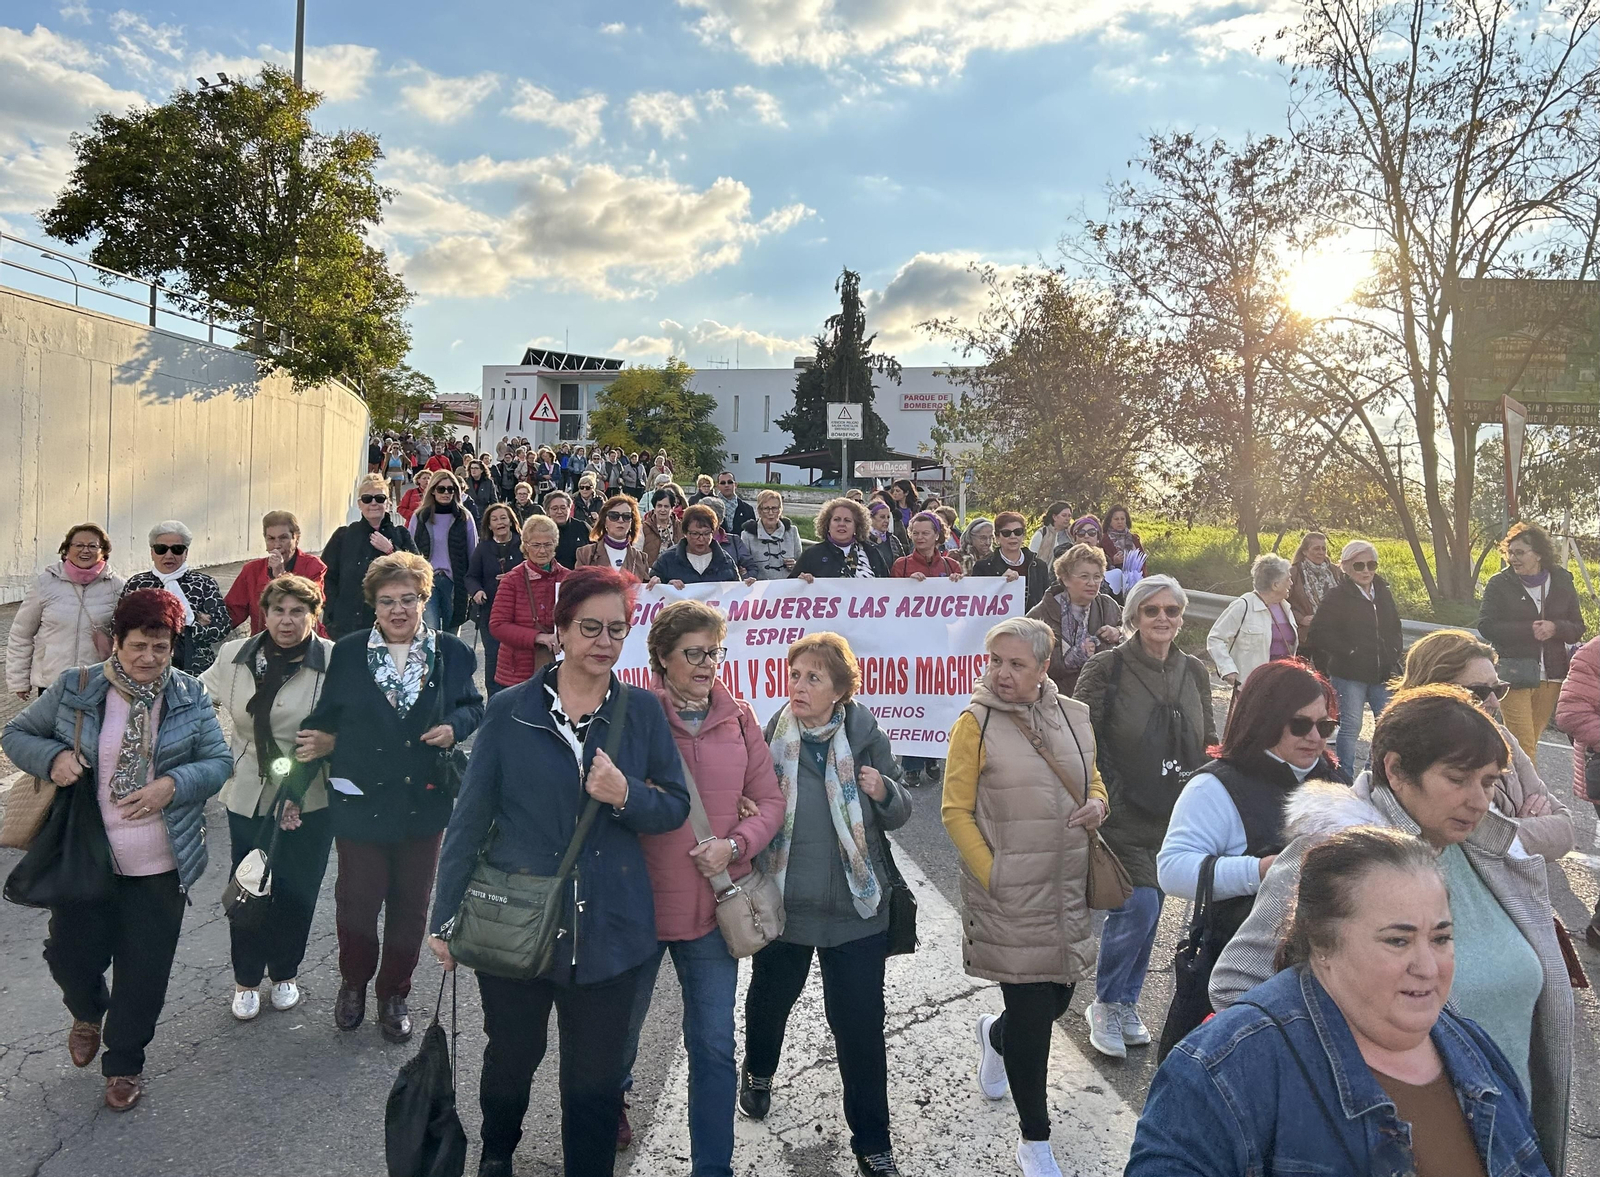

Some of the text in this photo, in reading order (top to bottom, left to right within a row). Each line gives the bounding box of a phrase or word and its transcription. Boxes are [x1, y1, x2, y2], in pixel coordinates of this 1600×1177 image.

[727, 597, 841, 621] MUJERES
[847, 596, 890, 619] LAS
[895, 594, 1013, 618] AZUCENAS
[748, 659, 758, 699] Y
[488, 893, 508, 904] YOUNG
